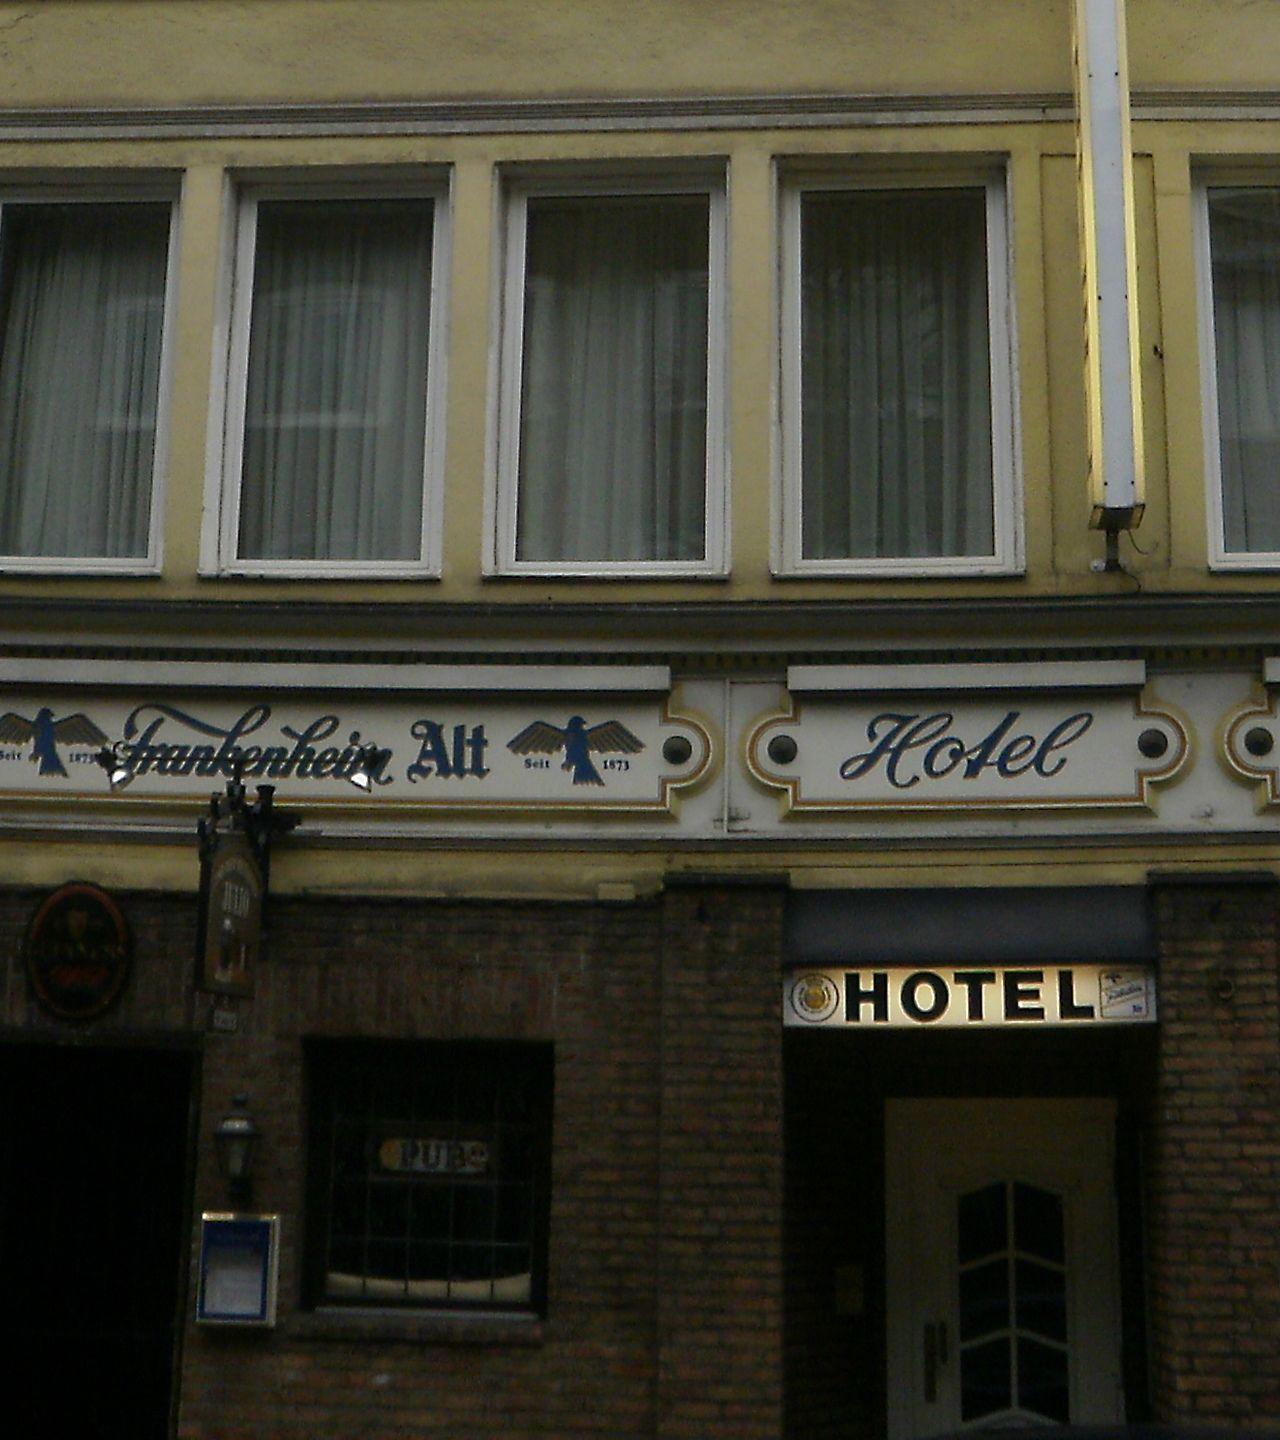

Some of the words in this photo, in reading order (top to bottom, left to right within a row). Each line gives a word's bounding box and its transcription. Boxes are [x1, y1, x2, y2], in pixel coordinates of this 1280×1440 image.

[407, 720, 490, 784] Alt
[524, 758, 550, 769] Seit
[603, 759, 630, 771] 1873
[839, 711, 1094, 789] Hotel
[844, 970, 1095, 1023] HOTEL
